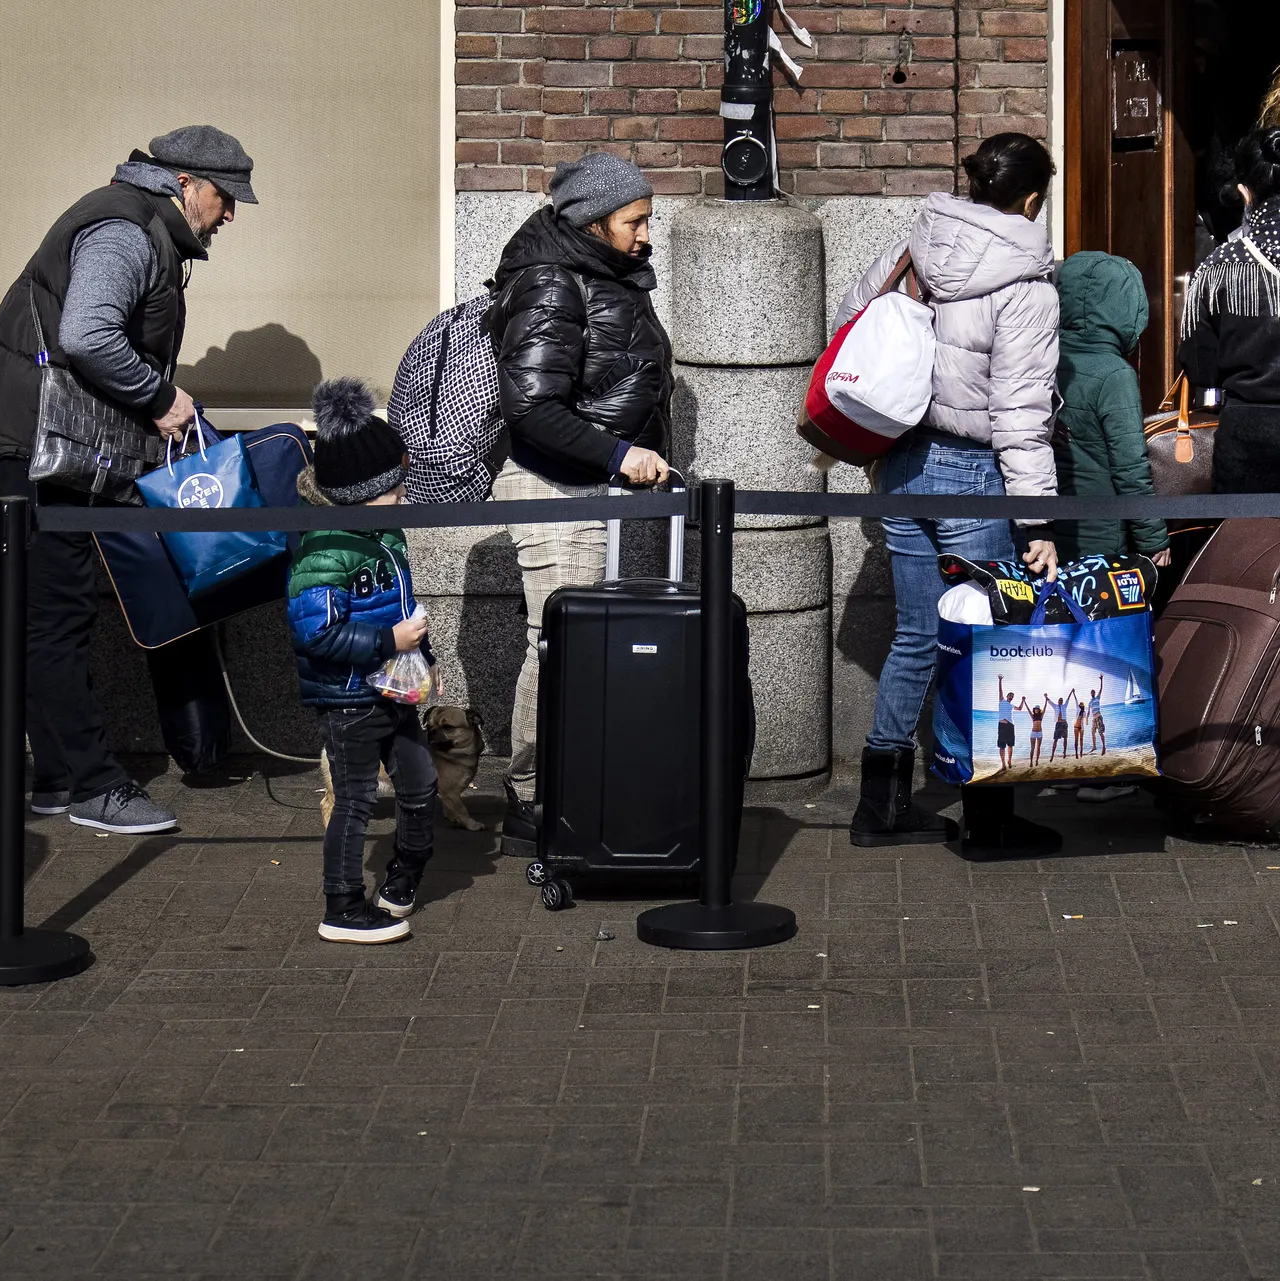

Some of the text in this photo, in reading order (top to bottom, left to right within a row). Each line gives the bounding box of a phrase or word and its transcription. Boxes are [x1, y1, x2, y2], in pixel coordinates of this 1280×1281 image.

[182, 484, 220, 507] BAYER
[353, 558, 395, 598] 84
[1117, 577, 1139, 588] ALDI
[990, 645, 1054, 658] boot.club
